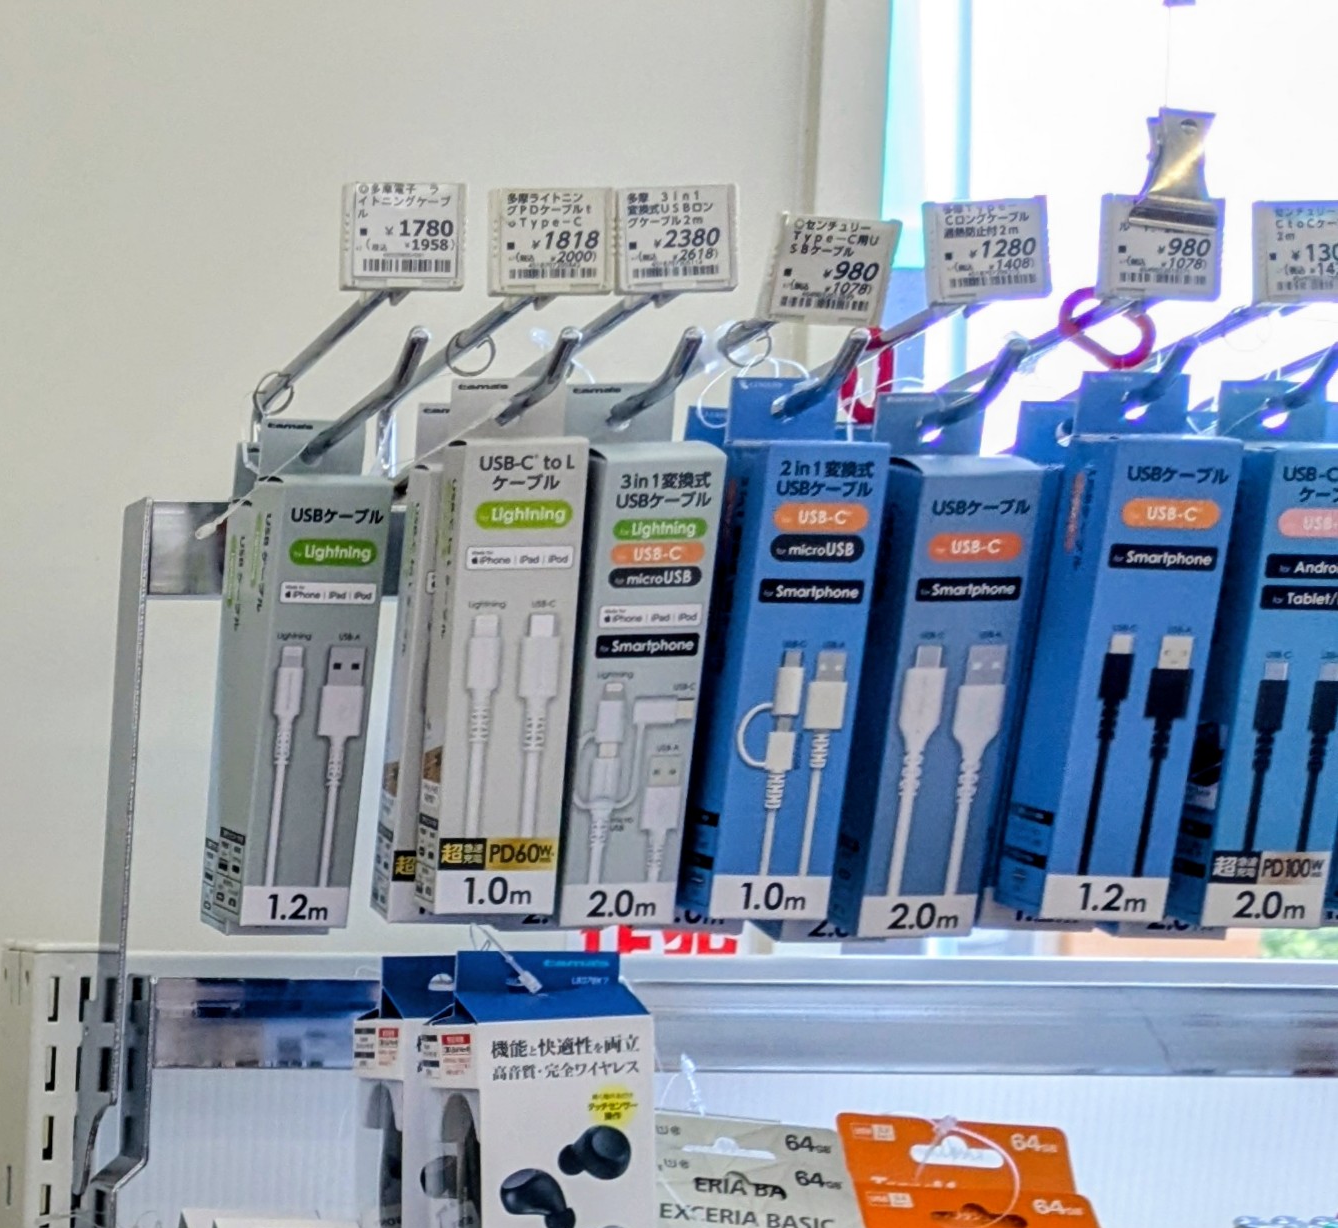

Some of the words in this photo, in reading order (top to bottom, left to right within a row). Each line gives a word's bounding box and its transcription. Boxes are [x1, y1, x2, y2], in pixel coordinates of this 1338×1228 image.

[544, 456, 563, 471] to
[566, 454, 575, 470] L
[493, 474, 560, 491] ケーブル
[1127, 465, 1229, 486] USBケーブル
[776, 479, 873, 498] USBケーブル
[616, 491, 712, 509] USBケーブル
[932, 499, 1031, 517] USBケーブル
[291, 507, 383, 526] USBケーブル
[492, 504, 567, 526] Lightning
[797, 508, 849, 526] USB-C
[1146, 505, 1199, 522] USB-C
[631, 521, 696, 539] Lightning
[304, 544, 372, 562] Lightning
[633, 545, 683, 562] USB-C
[788, 541, 855, 557] microUSB
[950, 537, 1002, 556] USB-C
[1126, 550, 1213, 568] Smartphone
[626, 567, 693, 586] microUSB
[775, 583, 859, 601] Smartphone
[931, 581, 1016, 598] Smartphone
[611, 637, 694, 655] Smartphone
[465, 876, 533, 906] 1.0m
[740, 882, 807, 912] 1.0m
[1077, 883, 1148, 914] 1.2m
[268, 893, 329, 921] 1.2m
[586, 890, 657, 919] 2.0m
[1232, 890, 1306, 921] 2.0m
[888, 903, 960, 931] 2.0m
[491, 1034, 640, 1060] 機能と快適性を両立
[659, 1202, 759, 1226] EXCERIA
